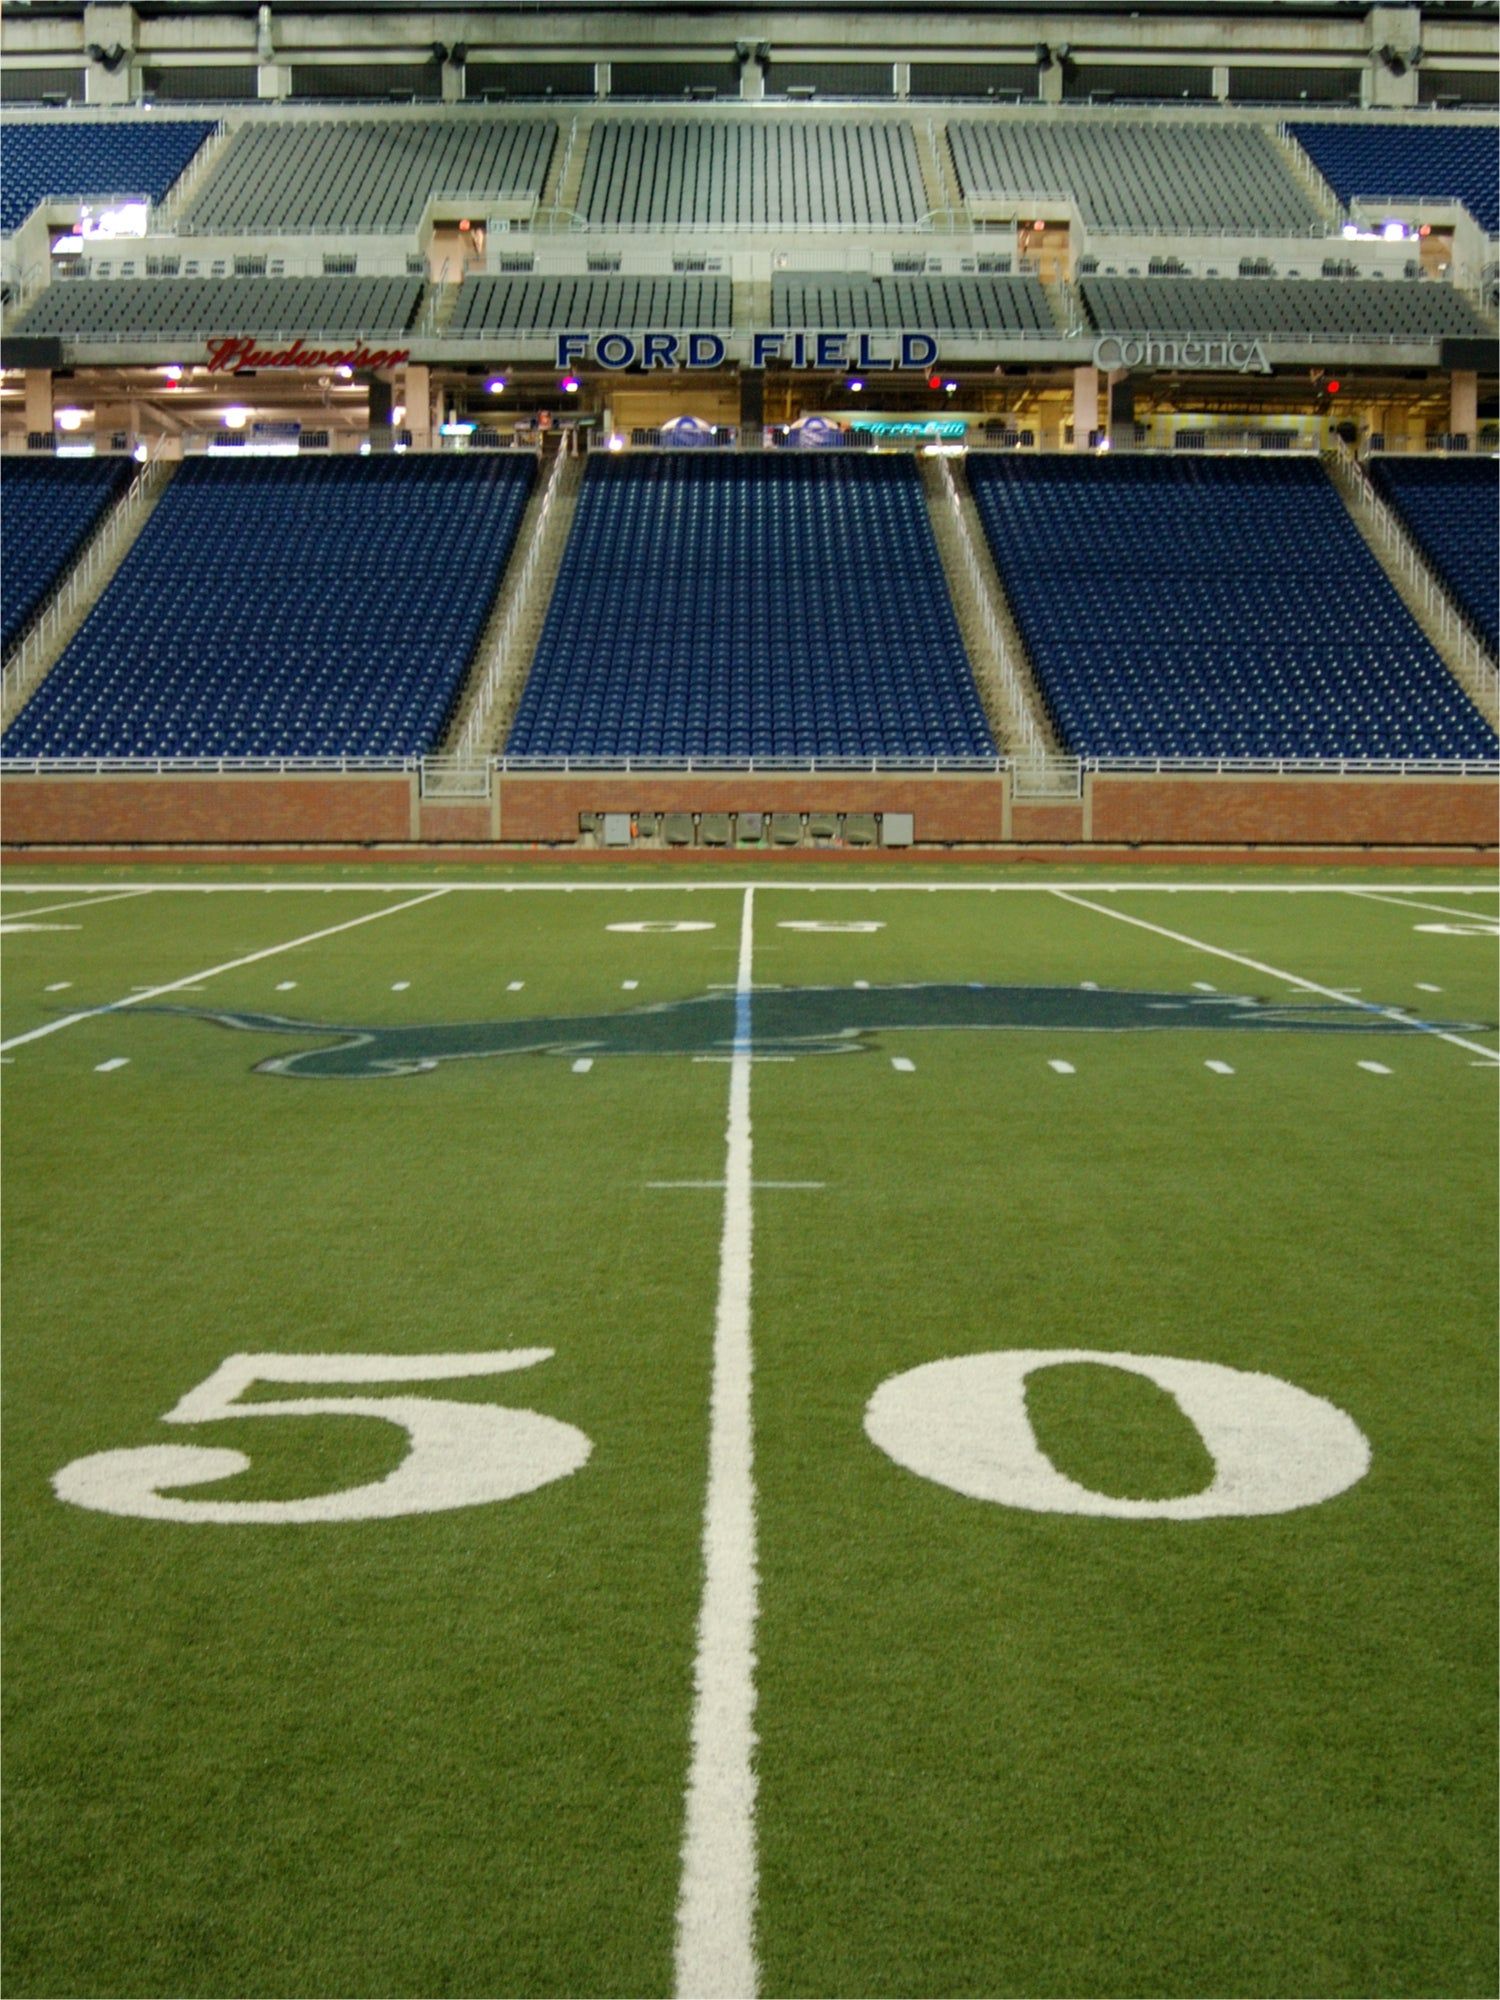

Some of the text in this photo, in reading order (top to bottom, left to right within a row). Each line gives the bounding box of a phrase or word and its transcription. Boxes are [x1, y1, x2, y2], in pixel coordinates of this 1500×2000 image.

[207, 337, 410, 373] Budweiser
[555, 333, 941, 370] FORD FIELD
[53, 1347, 1371, 1524] 5 0
